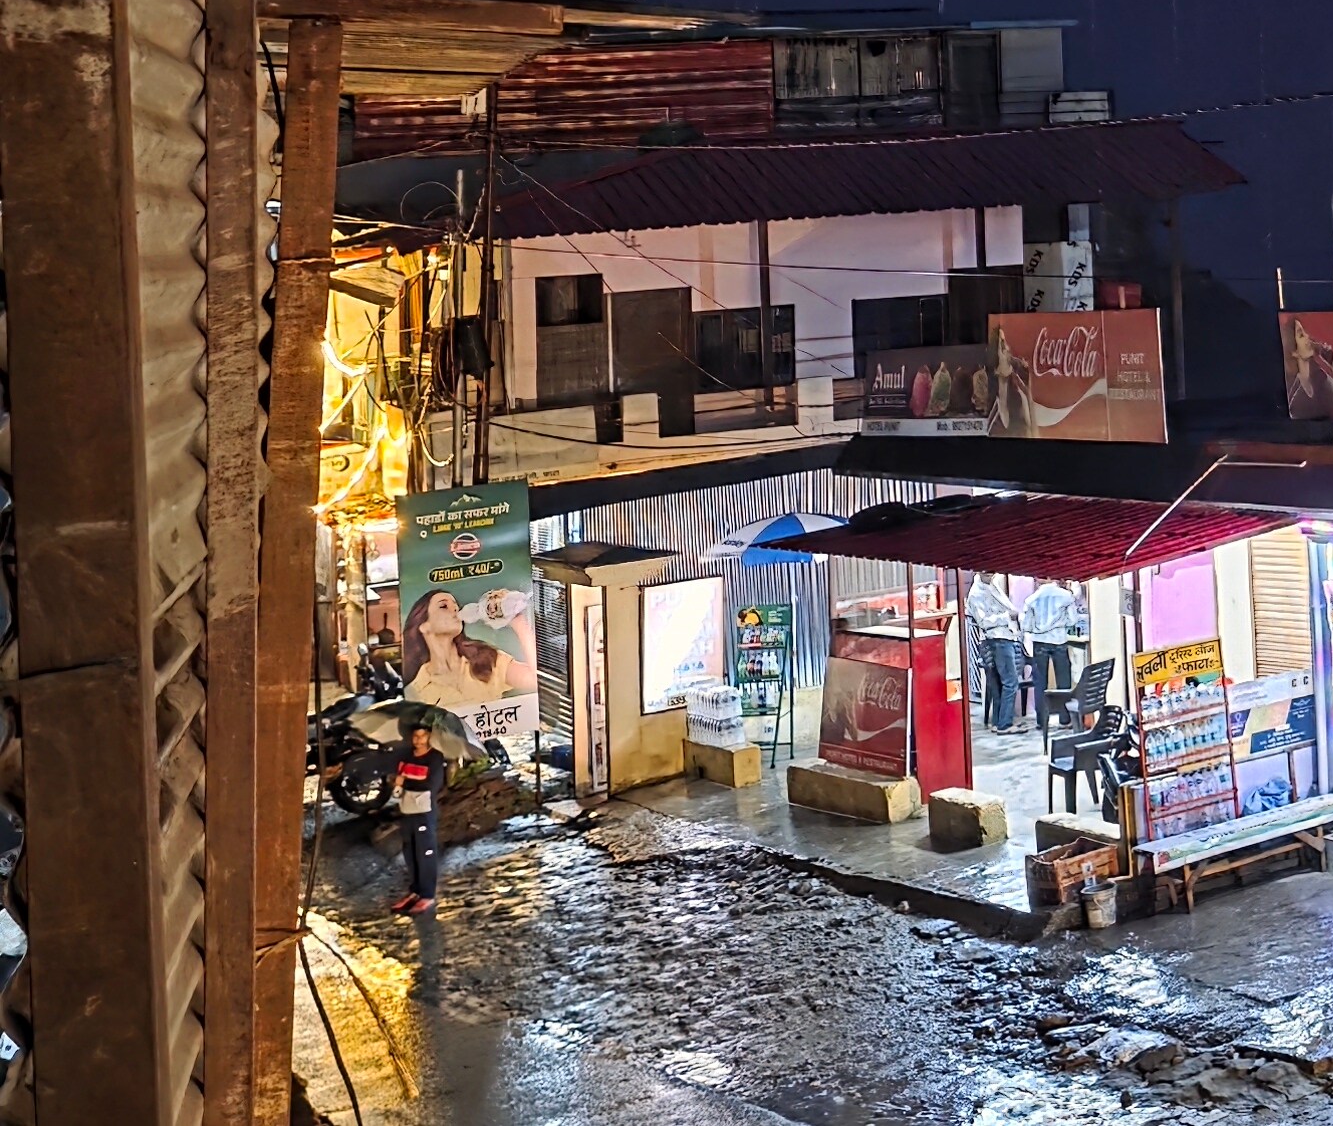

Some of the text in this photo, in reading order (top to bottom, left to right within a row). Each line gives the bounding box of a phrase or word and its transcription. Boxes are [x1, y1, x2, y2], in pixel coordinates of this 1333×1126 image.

[1032, 325, 1099, 378] Coca-Cola
[872, 363, 905, 392] Amul
[432, 567, 464, 581] 750ml
[473, 705, 522, 729] होटल
